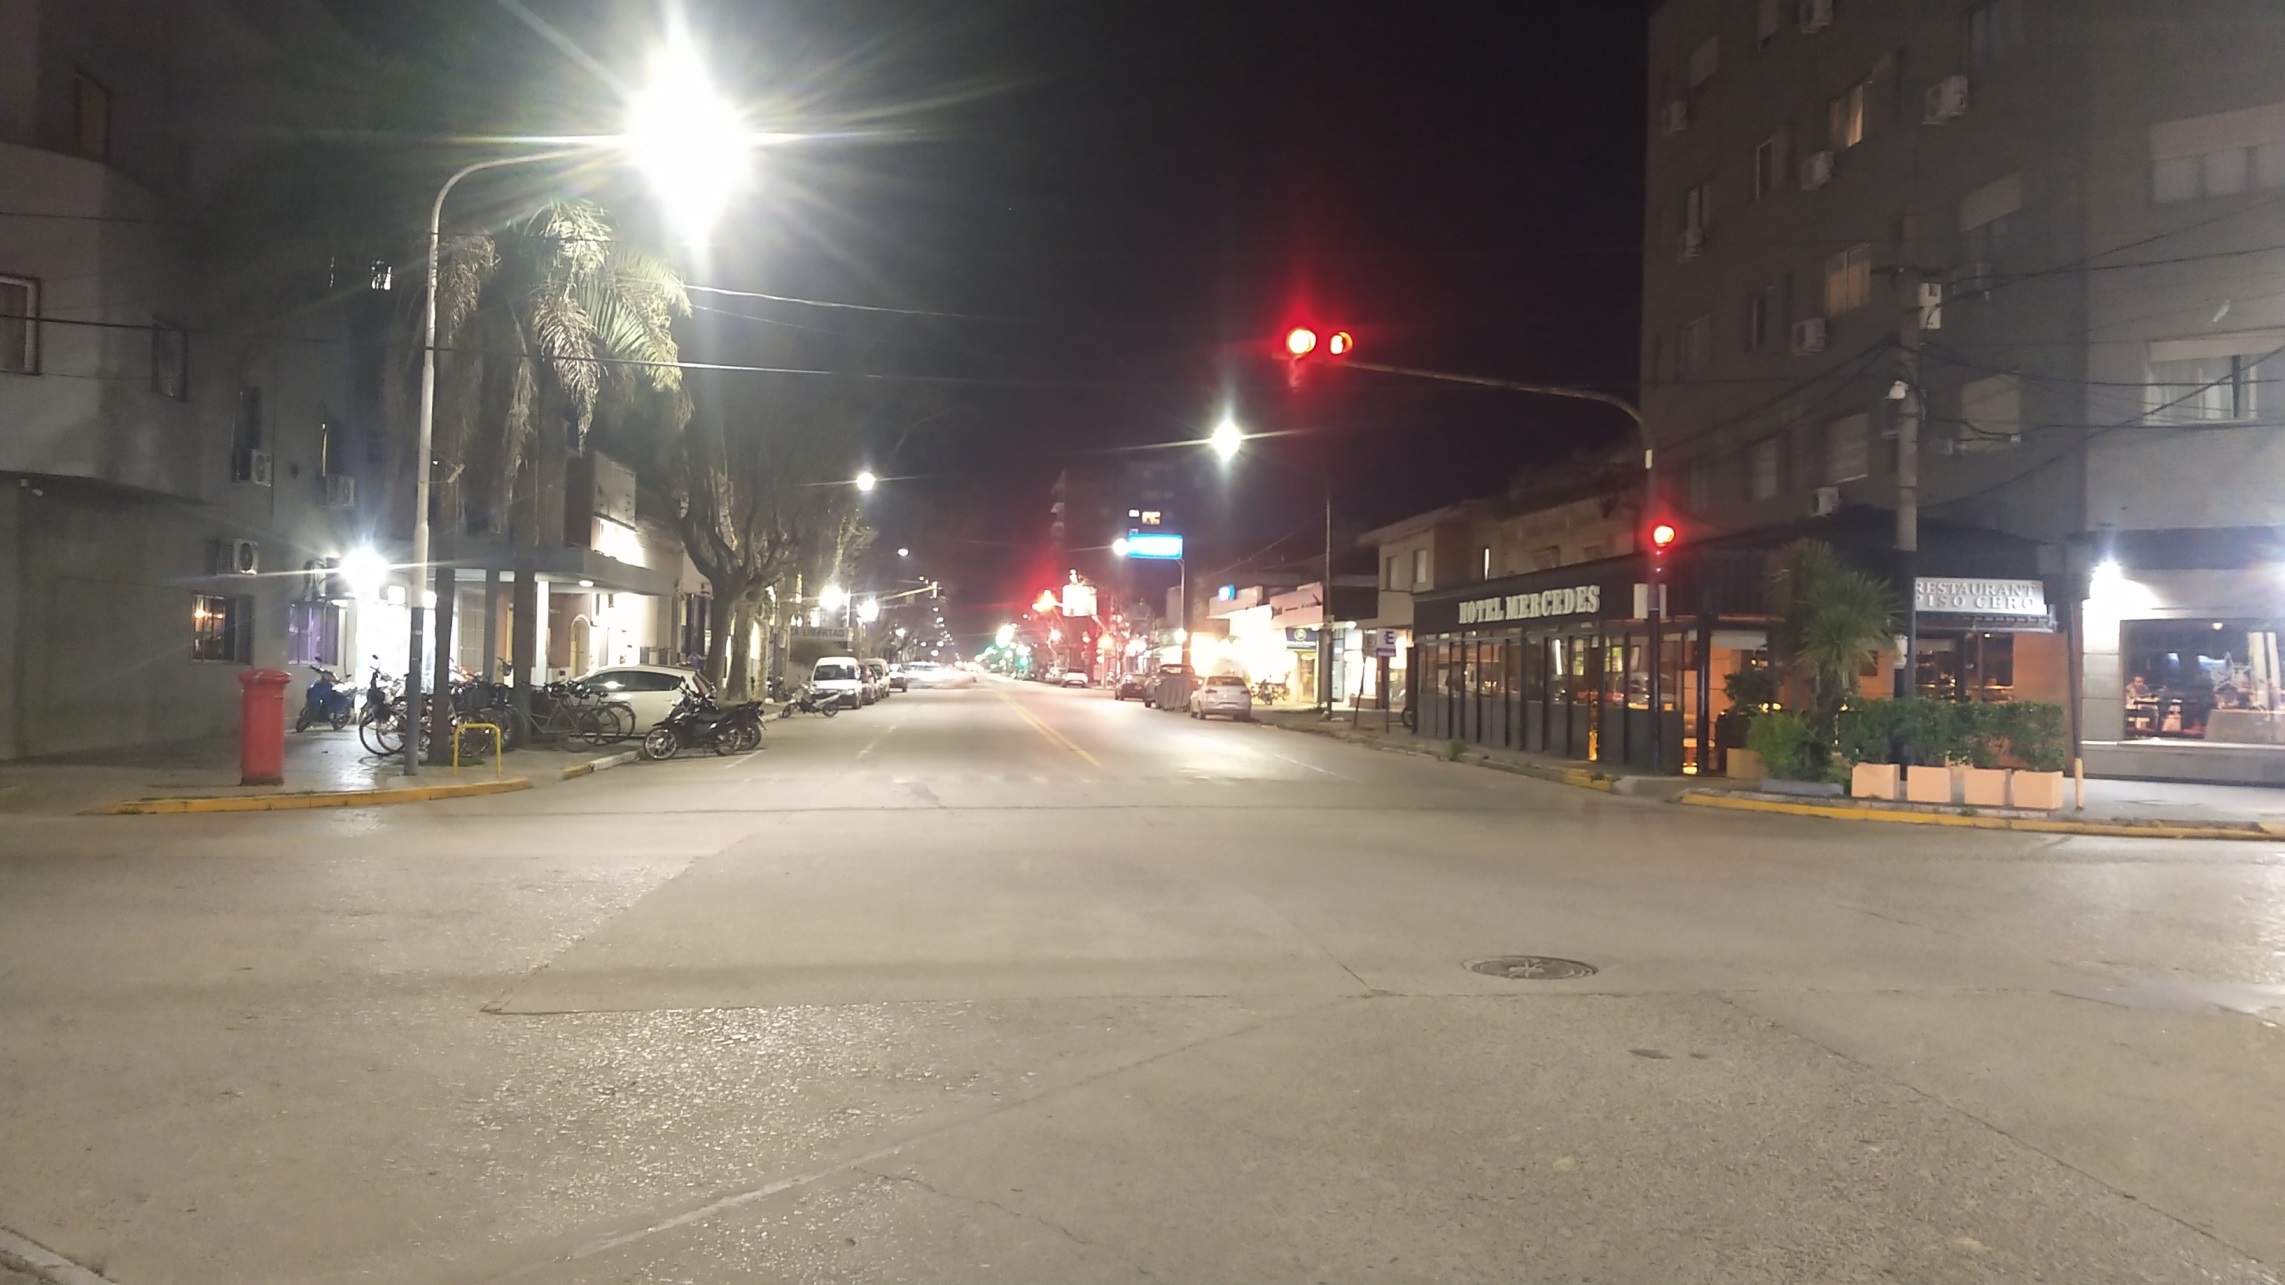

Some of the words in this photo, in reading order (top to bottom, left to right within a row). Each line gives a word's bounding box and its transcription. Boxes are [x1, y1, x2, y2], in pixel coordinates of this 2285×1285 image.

[1916, 582, 2034, 597] RESTAURANT
[1459, 598, 1503, 624] HOTEL
[1506, 585, 1600, 620] MERCEDES
[1975, 596, 2034, 609] CERO
[1385, 631, 1394, 645] E
